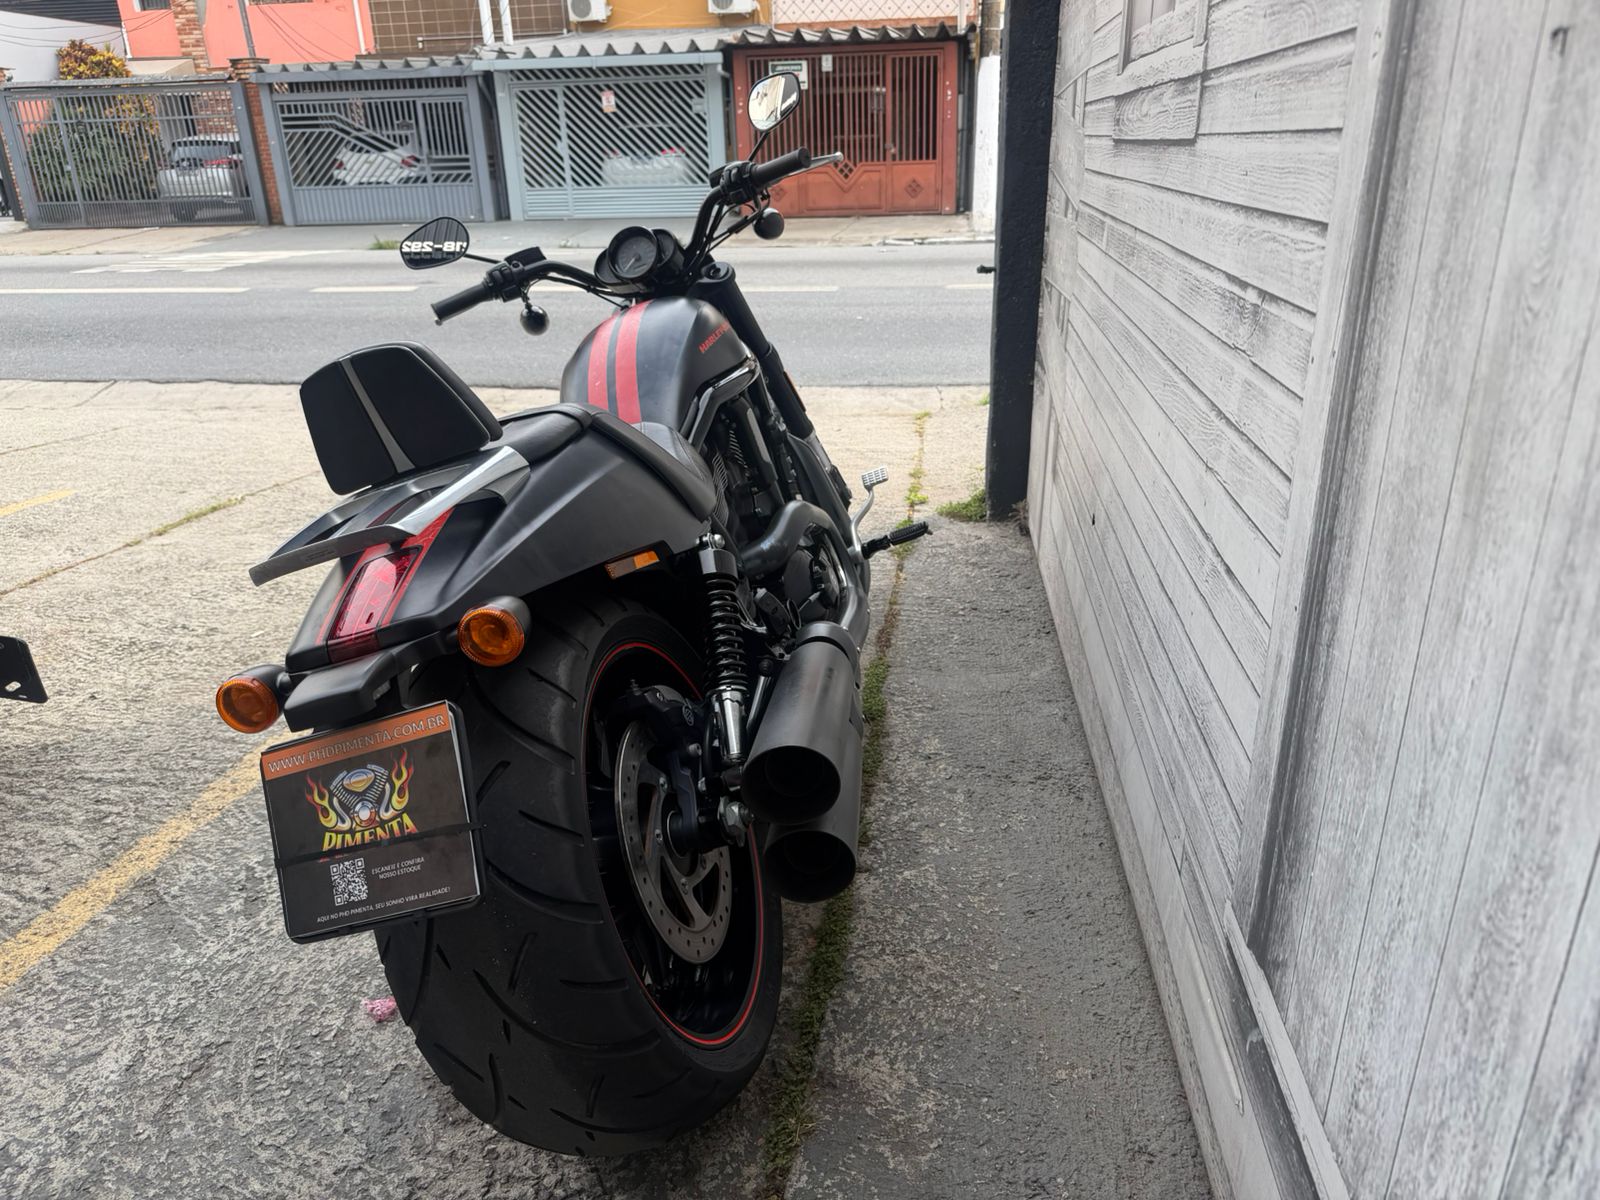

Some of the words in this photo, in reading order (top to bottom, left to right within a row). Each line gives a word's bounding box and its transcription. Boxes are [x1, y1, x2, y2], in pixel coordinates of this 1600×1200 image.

[268, 713, 445, 773] WWW.PHDPIMENTA.COM.BR
[319, 812, 418, 862] PIMENTA
[379, 871, 396, 879] NOSSO
[397, 864, 421, 875] ESTOQUE
[401, 856, 424, 867] CONFIRA
[317, 915, 329, 923] AQUI
[385, 897, 405, 907] SONHO
[405, 894, 418, 902] VIRA
